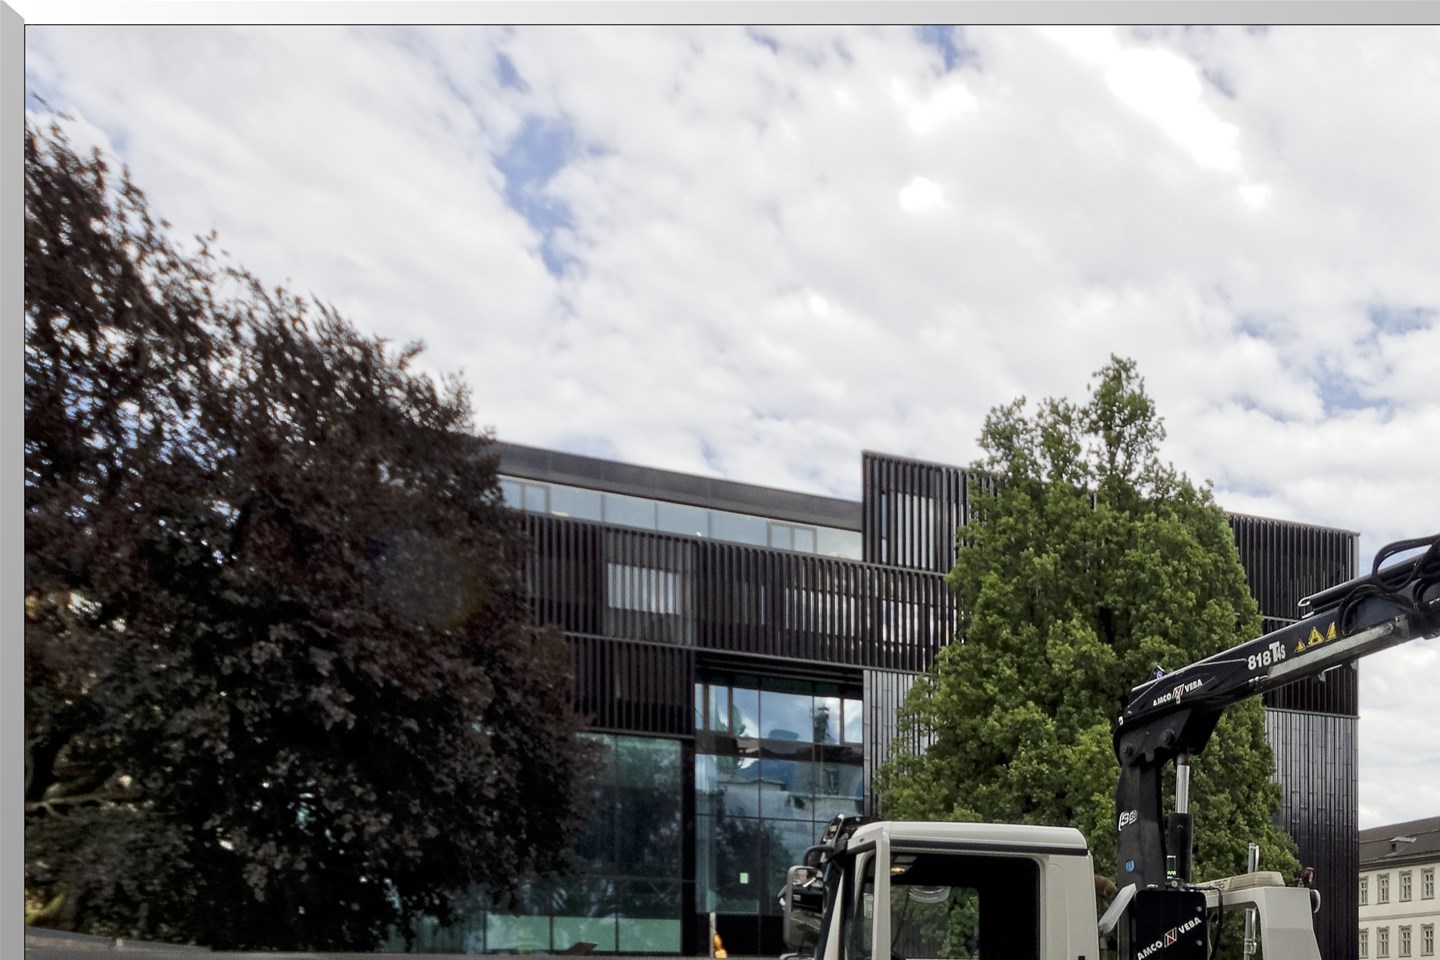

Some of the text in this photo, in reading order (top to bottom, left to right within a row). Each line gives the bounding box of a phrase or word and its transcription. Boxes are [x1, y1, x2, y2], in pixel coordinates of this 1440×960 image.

[1153, 678, 1203, 707] AMCO VEBA
[1137, 917, 1202, 960] AMCO VEBA
